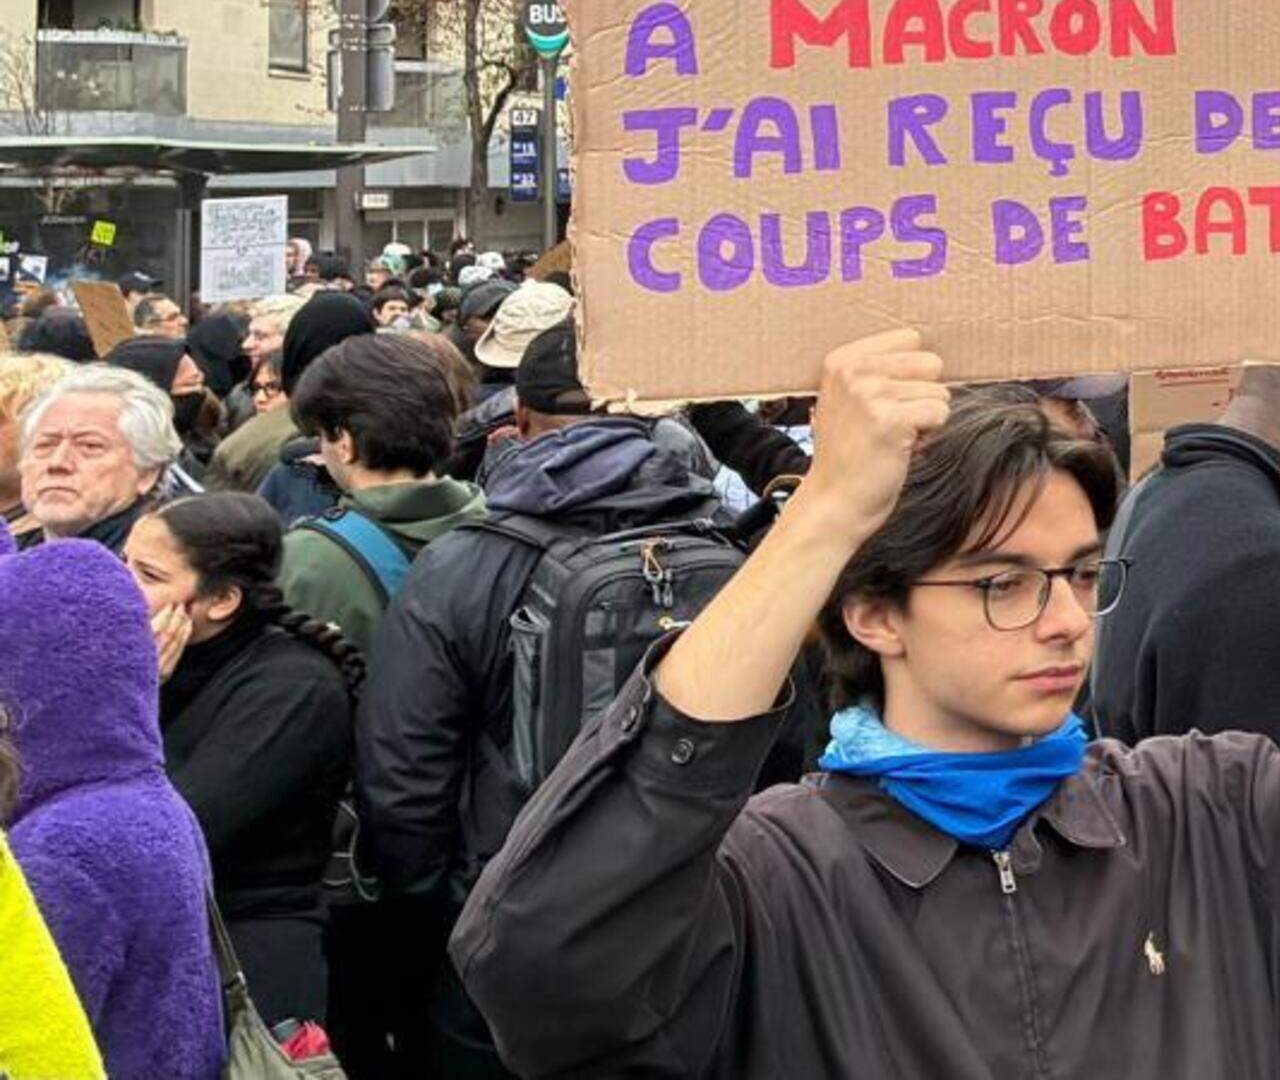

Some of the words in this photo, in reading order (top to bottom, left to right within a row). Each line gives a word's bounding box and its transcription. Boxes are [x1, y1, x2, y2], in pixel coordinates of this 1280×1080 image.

[622, 98, 840, 184] J'AI
[888, 90, 1143, 176] REÇU
[628, 194, 947, 291] COUPS
[994, 198, 1090, 263] DE
